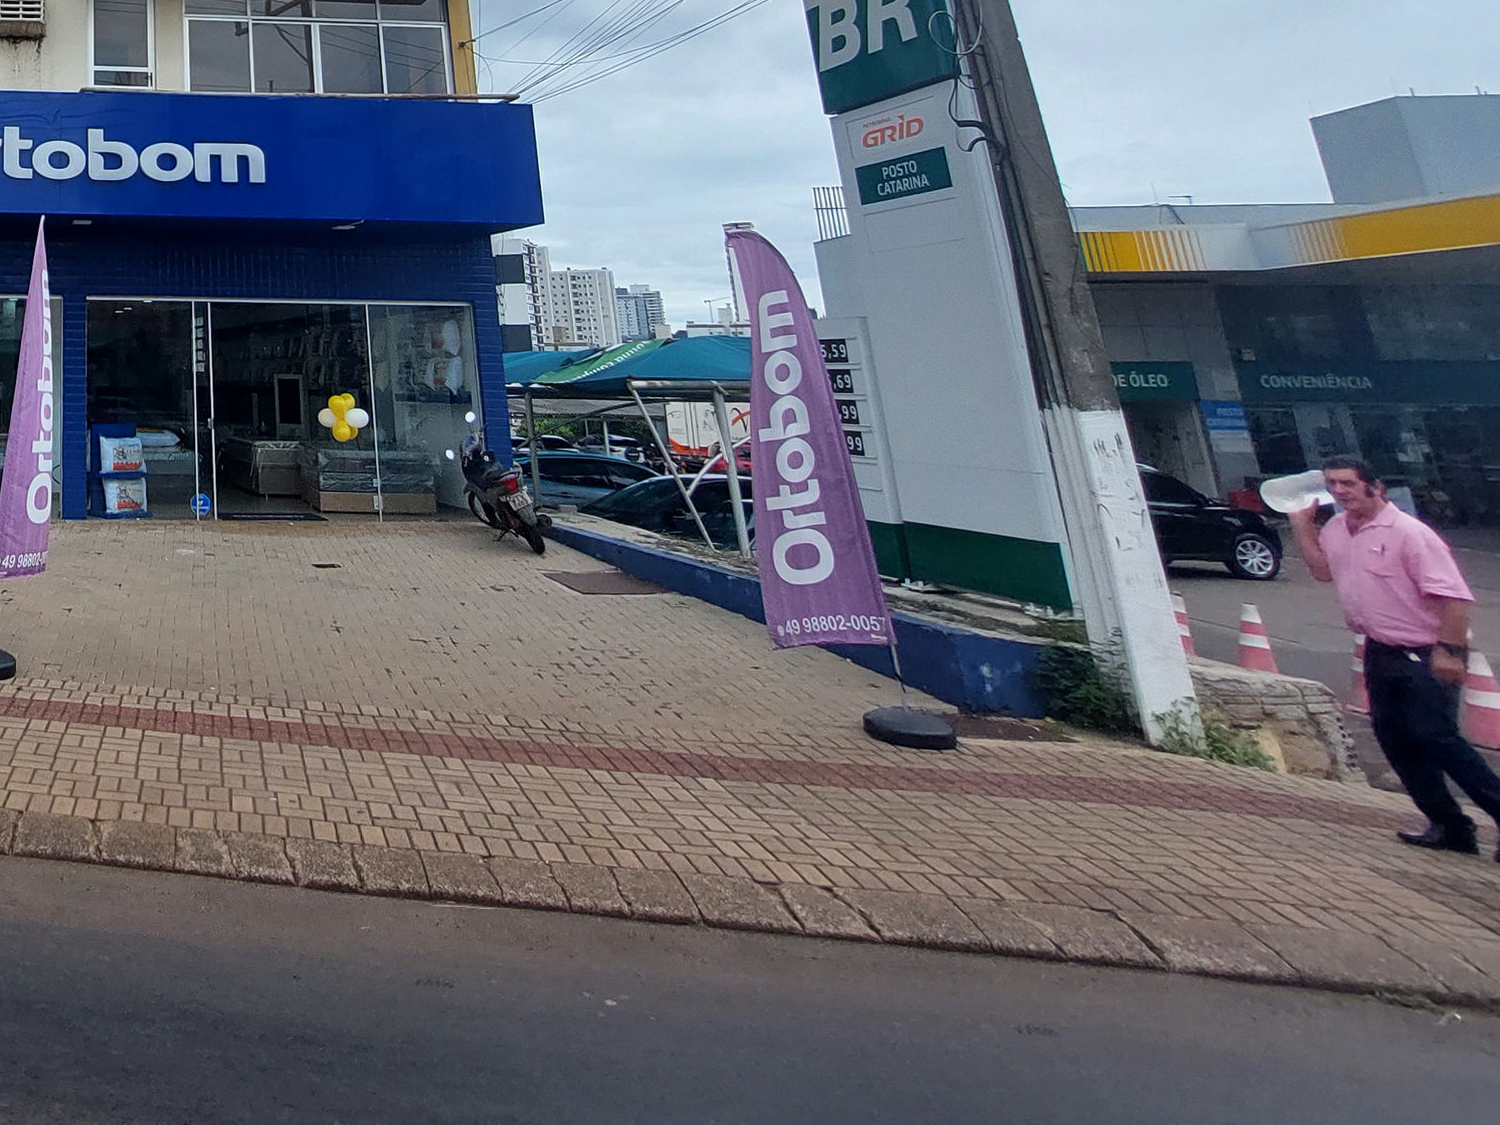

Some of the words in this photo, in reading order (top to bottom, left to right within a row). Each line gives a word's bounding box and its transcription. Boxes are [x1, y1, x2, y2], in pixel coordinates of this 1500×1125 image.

[882, 160, 917, 179] POSTO
[877, 174, 930, 196] CATARINA
[833, 375, 851, 389] ,69
[1130, 370, 1168, 387] ÓLEO
[1260, 372, 1372, 389] CONVENIÊNCIA
[26, 268, 53, 524] Ortobom
[758, 289, 835, 585] Ortobom
[2, 554, 16, 569] 49
[785, 619, 800, 635] 49
[802, 614, 885, 633] 98802-0057
